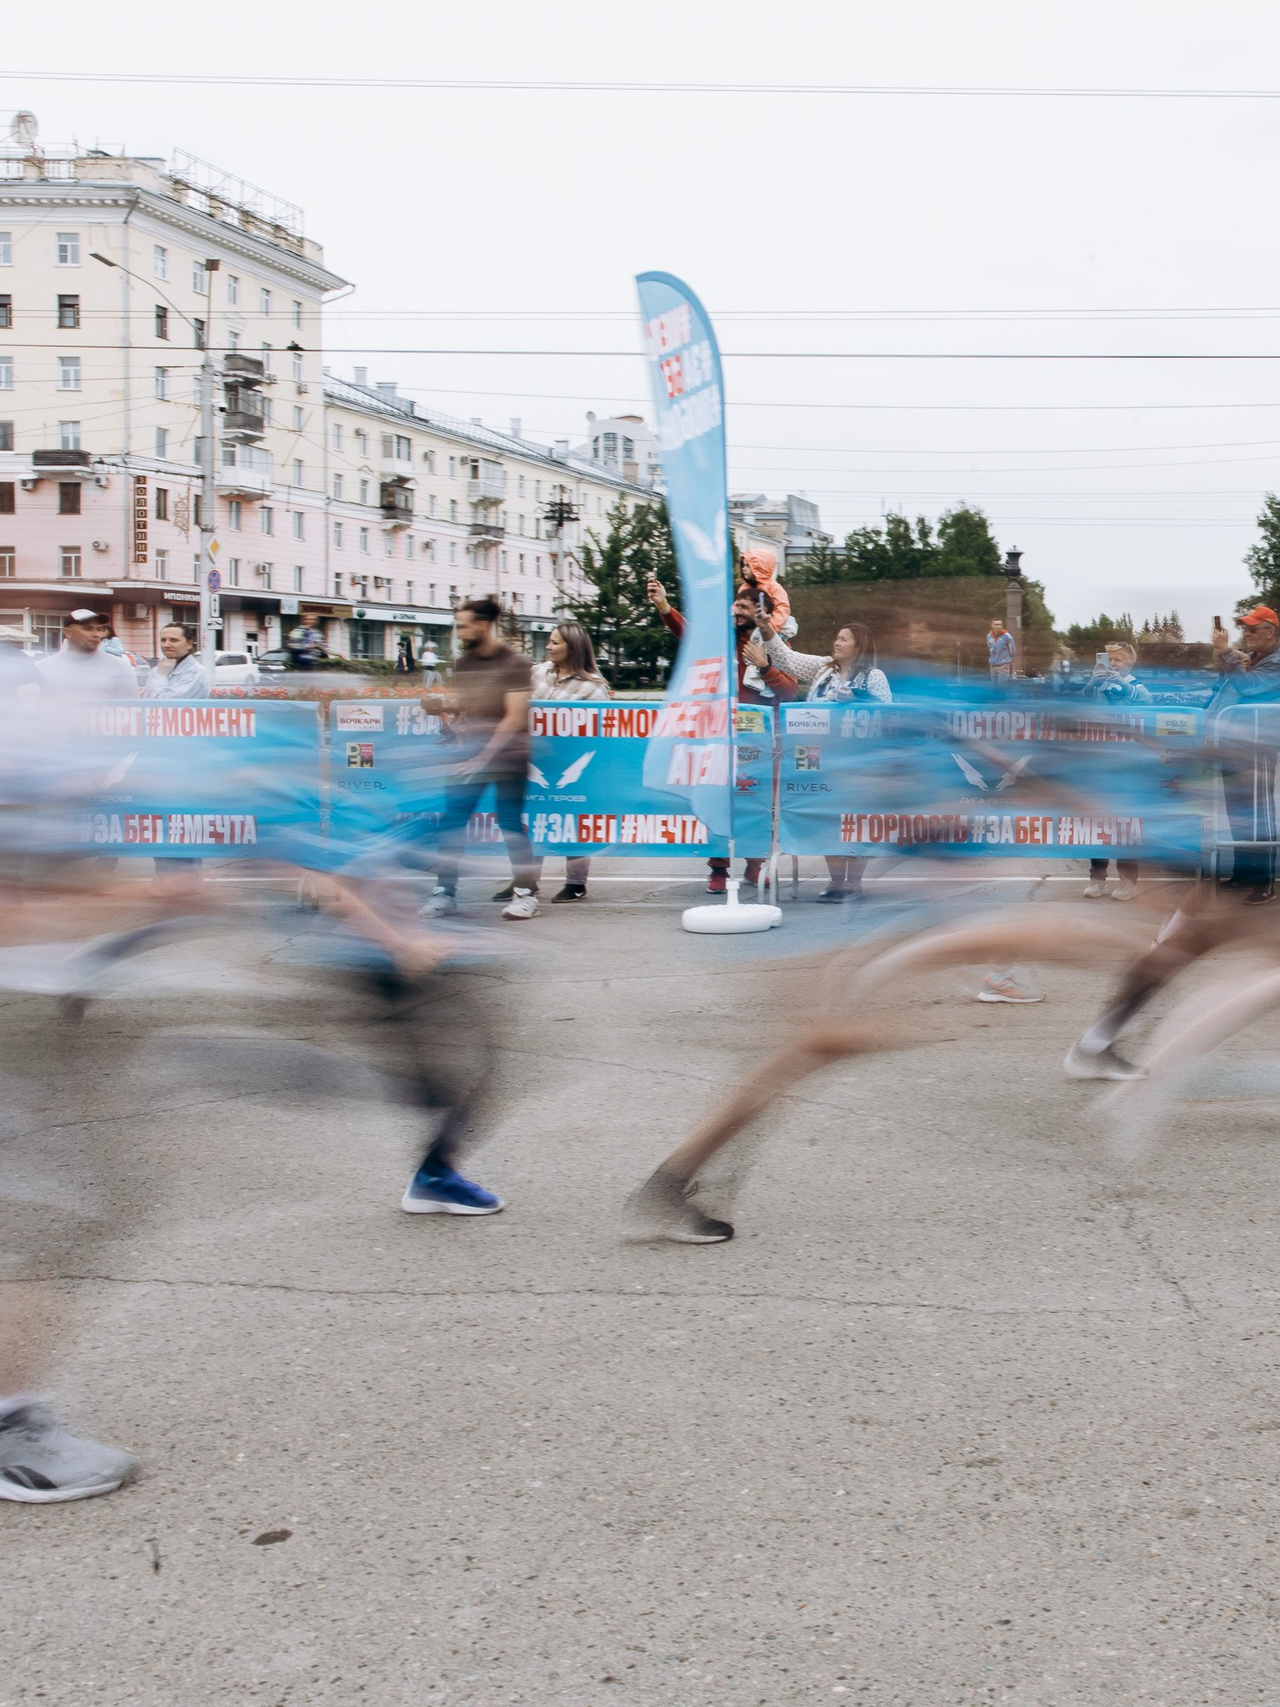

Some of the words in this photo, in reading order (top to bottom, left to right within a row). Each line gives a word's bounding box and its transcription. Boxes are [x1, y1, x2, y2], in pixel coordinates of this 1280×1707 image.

[137, 476, 147, 563] ЗОЛОТНИК
[145, 707, 257, 738] #МОМЕНТ
[527, 706, 599, 737] СТОРГ
[788, 720, 829, 728] БОЧКАРИ
[338, 781, 387, 790] RIVER
[548, 795, 588, 803] ГЕРОЕВ
[787, 782, 833, 792] RIVER
[81, 813, 163, 844] #ЗАБЕГ
[168, 814, 258, 844] #МЕЧТА
[532, 813, 617, 844] #ЗАБЕГ
[621, 814, 709, 844] #МЕЧТА
[841, 813, 968, 847] #ГОРДОСТЬ
[971, 815, 1054, 844] #ЗАБЕГ
[1057, 816, 1144, 846] #МЕЧТА
